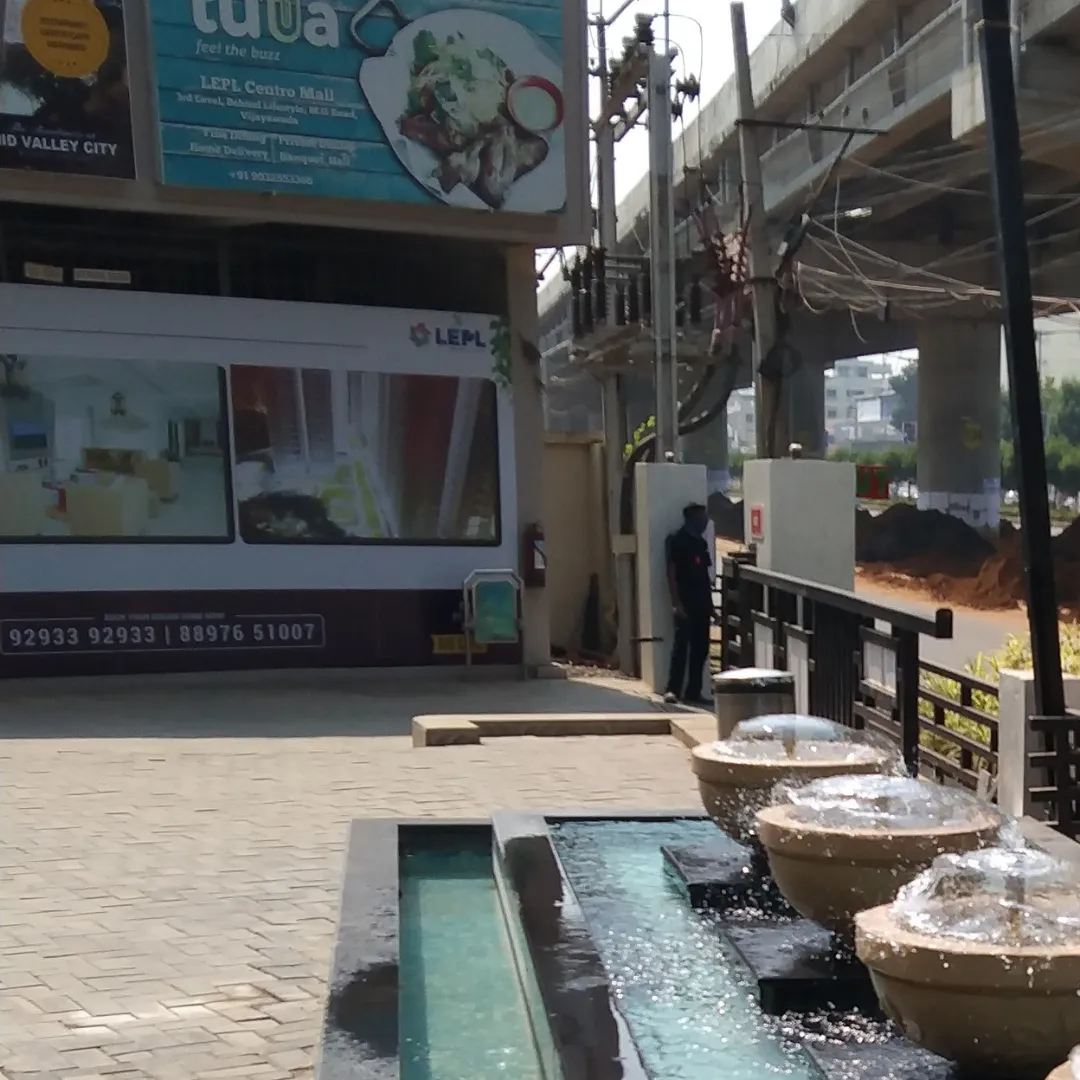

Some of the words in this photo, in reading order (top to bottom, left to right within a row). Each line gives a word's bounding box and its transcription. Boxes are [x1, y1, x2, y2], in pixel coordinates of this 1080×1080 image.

[196, 39, 221, 55] feel
[226, 43, 246, 58] the
[251, 46, 280, 60] buzz
[201, 75, 241, 93] LEPL
[245, 80, 296, 98] Centro
[300, 86, 335, 102] Mall
[0, 134, 17, 147] ID
[20, 135, 79, 153] VALLEY
[83, 141, 118, 157] CITY
[435, 327, 487, 347] LEPL
[9, 627, 80, 646] 92933
[89, 626, 156, 645] 92933
[179, 624, 245, 642] 88976
[253, 623, 316, 641] 51007
